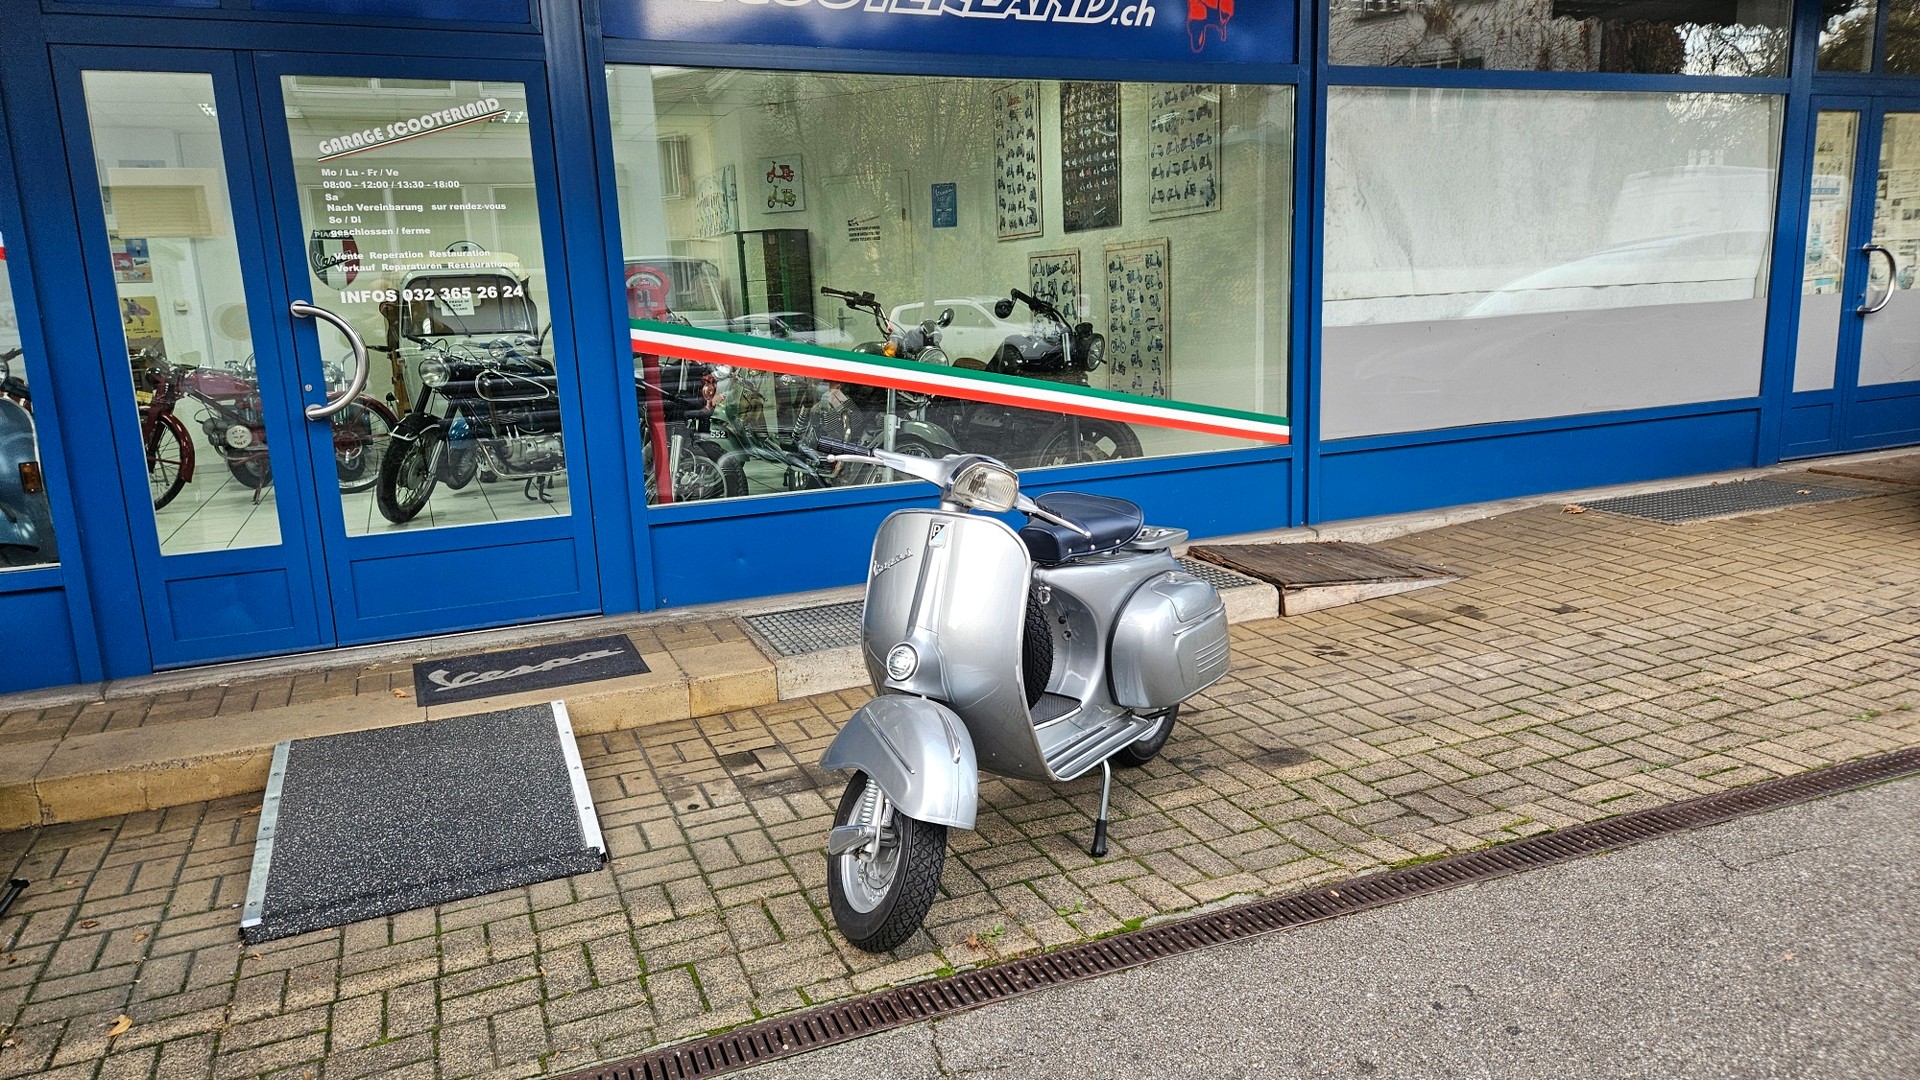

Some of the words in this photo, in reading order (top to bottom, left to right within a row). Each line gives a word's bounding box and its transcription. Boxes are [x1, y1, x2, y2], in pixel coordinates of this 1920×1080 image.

[318, 127, 385, 155] GARAGE
[386, 98, 500, 139] SCOOTERLAND
[321, 168, 337, 177] Mo
[345, 168, 358, 177] Lu
[367, 168, 378, 177] Fr
[385, 168, 399, 177] Ve
[322, 180, 351, 189] 08:00
[361, 180, 389, 189] 12:00
[397, 180, 424, 189] 13:30
[433, 180, 460, 188] 18:00
[325, 193, 339, 201] Sa
[327, 204, 354, 212] Nach
[356, 203, 424, 213] Vereinbarung
[449, 203, 507, 211] rendez-vous
[328, 216, 342, 224] So
[350, 215, 362, 223] Di
[330, 228, 394, 238] geschlossen
[401, 227, 431, 235] ferme
[333, 252, 364, 260] Vente
[369, 251, 424, 260] Reperation
[429, 249, 490, 258] Restauration
[335, 263, 375, 272] Verkauf
[381, 262, 442, 272] Reparaturen
[447, 260, 520, 270] Restaurationen
[340, 289, 398, 304] INFOS
[402, 288, 435, 302] 032
[440, 287, 472, 301] 365
[477, 286, 498, 299] 26
[503, 285, 524, 298] 24
